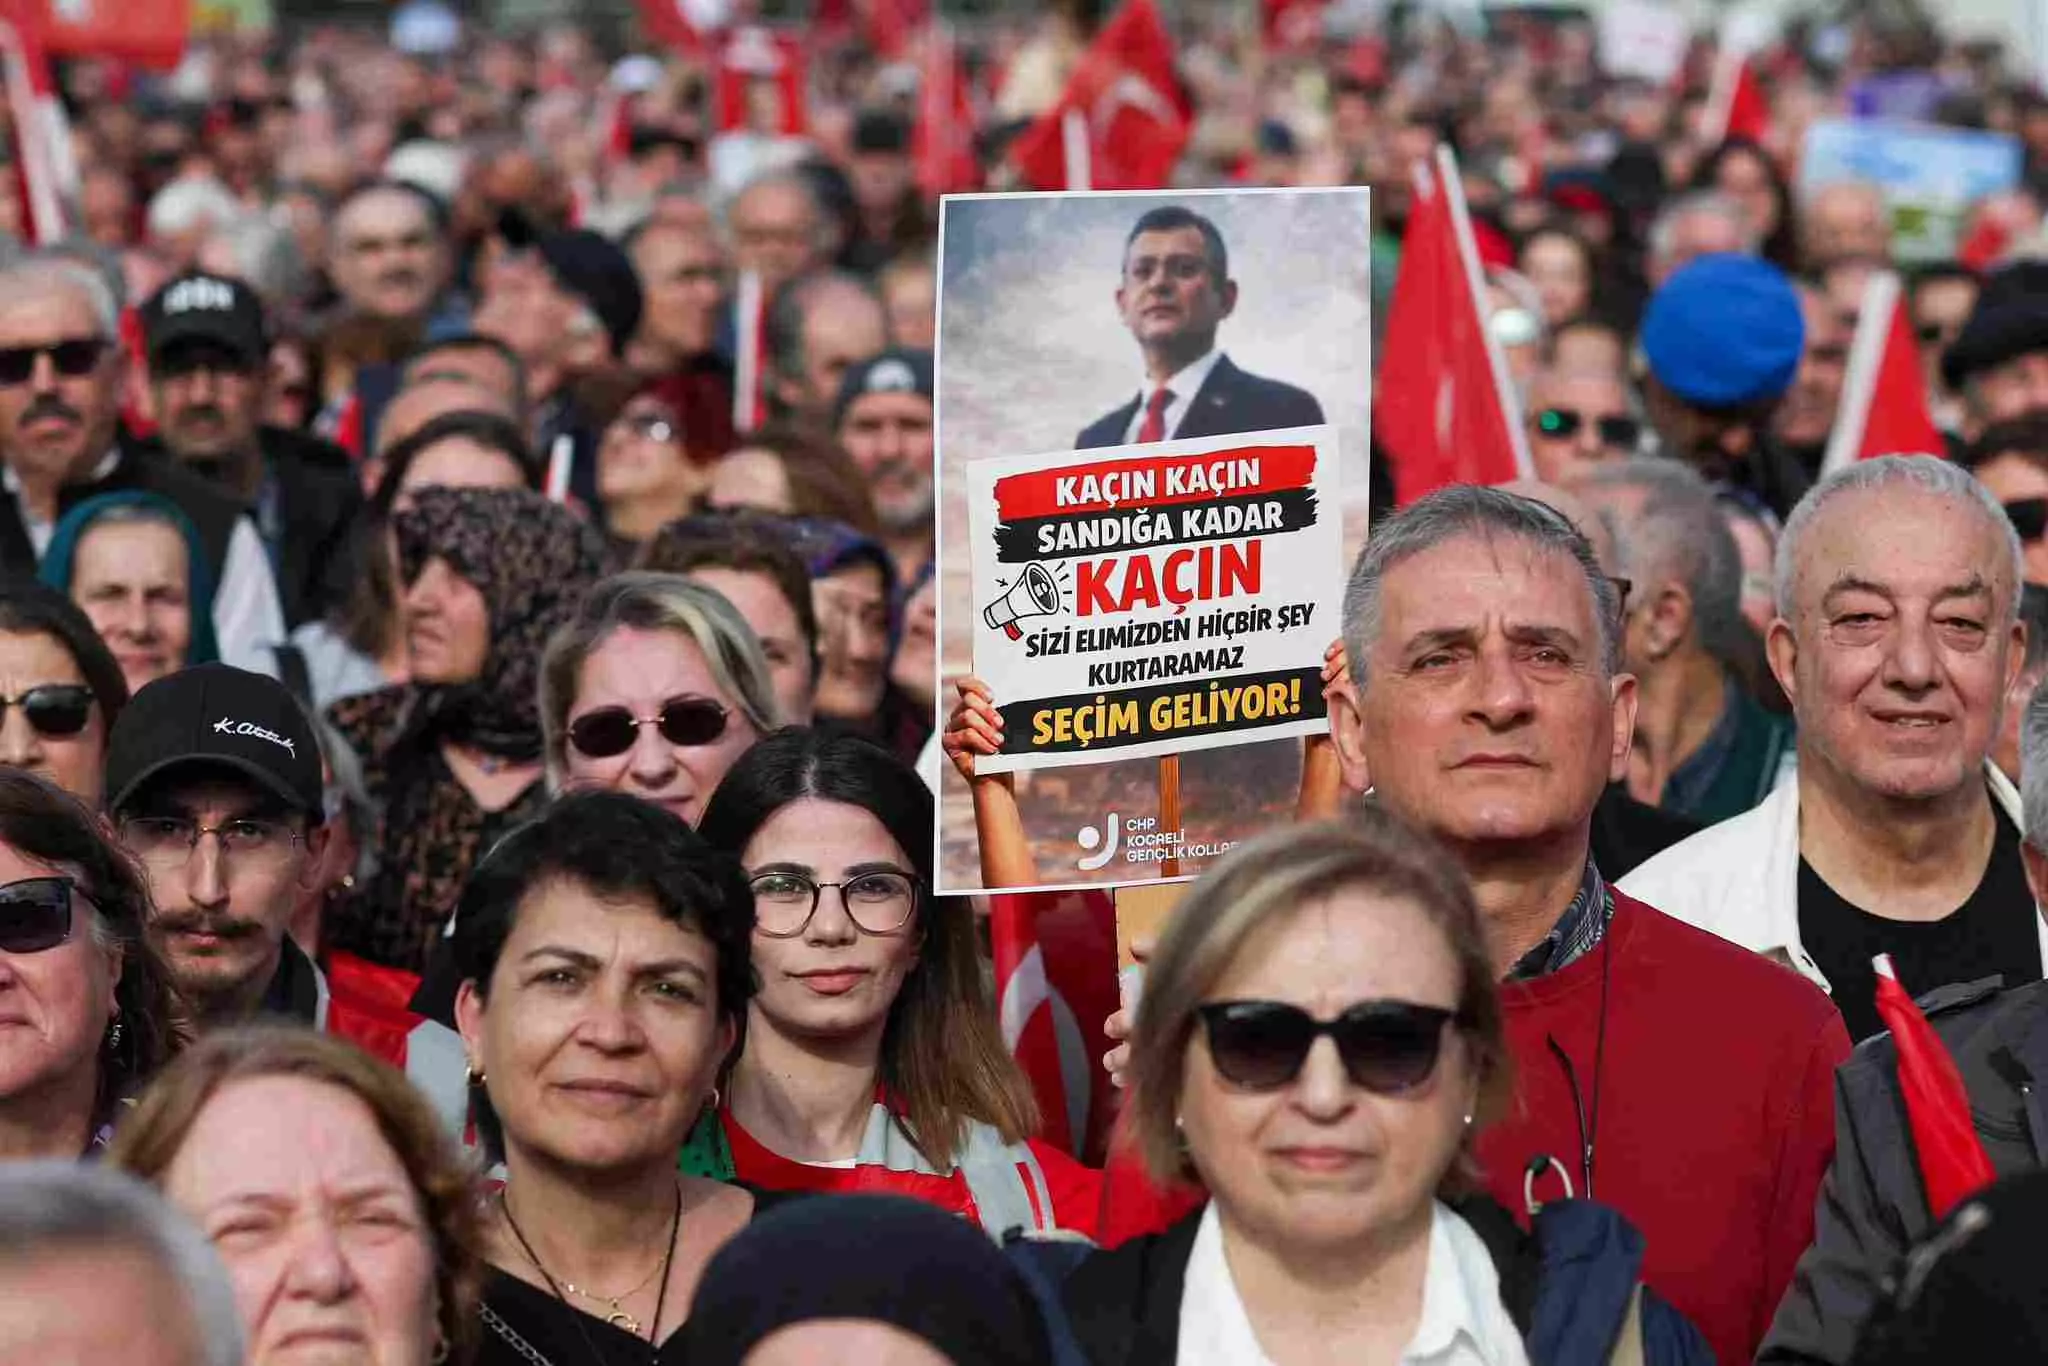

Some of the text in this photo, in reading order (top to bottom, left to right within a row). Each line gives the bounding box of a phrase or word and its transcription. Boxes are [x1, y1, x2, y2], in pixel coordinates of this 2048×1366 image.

[1056, 458, 1261, 508] KAÇIN KAÇIN
[1037, 501, 1284, 553] SANDIĞA KADAR
[1076, 539, 1262, 617] KAÇIN
[1025, 626, 1071, 658] SİZİ
[1197, 604, 1272, 640] HİÇBİR
[1277, 602, 1315, 633] ŞEY
[1088, 646, 1244, 687] KURTARAMAZ
[1032, 678, 1301, 747] SEÇİM GELİYOR!
[1126, 817, 1156, 832] CHP
[1126, 829, 1185, 848] KOCAELİ
[1126, 844, 1186, 863] GENÇLİK
